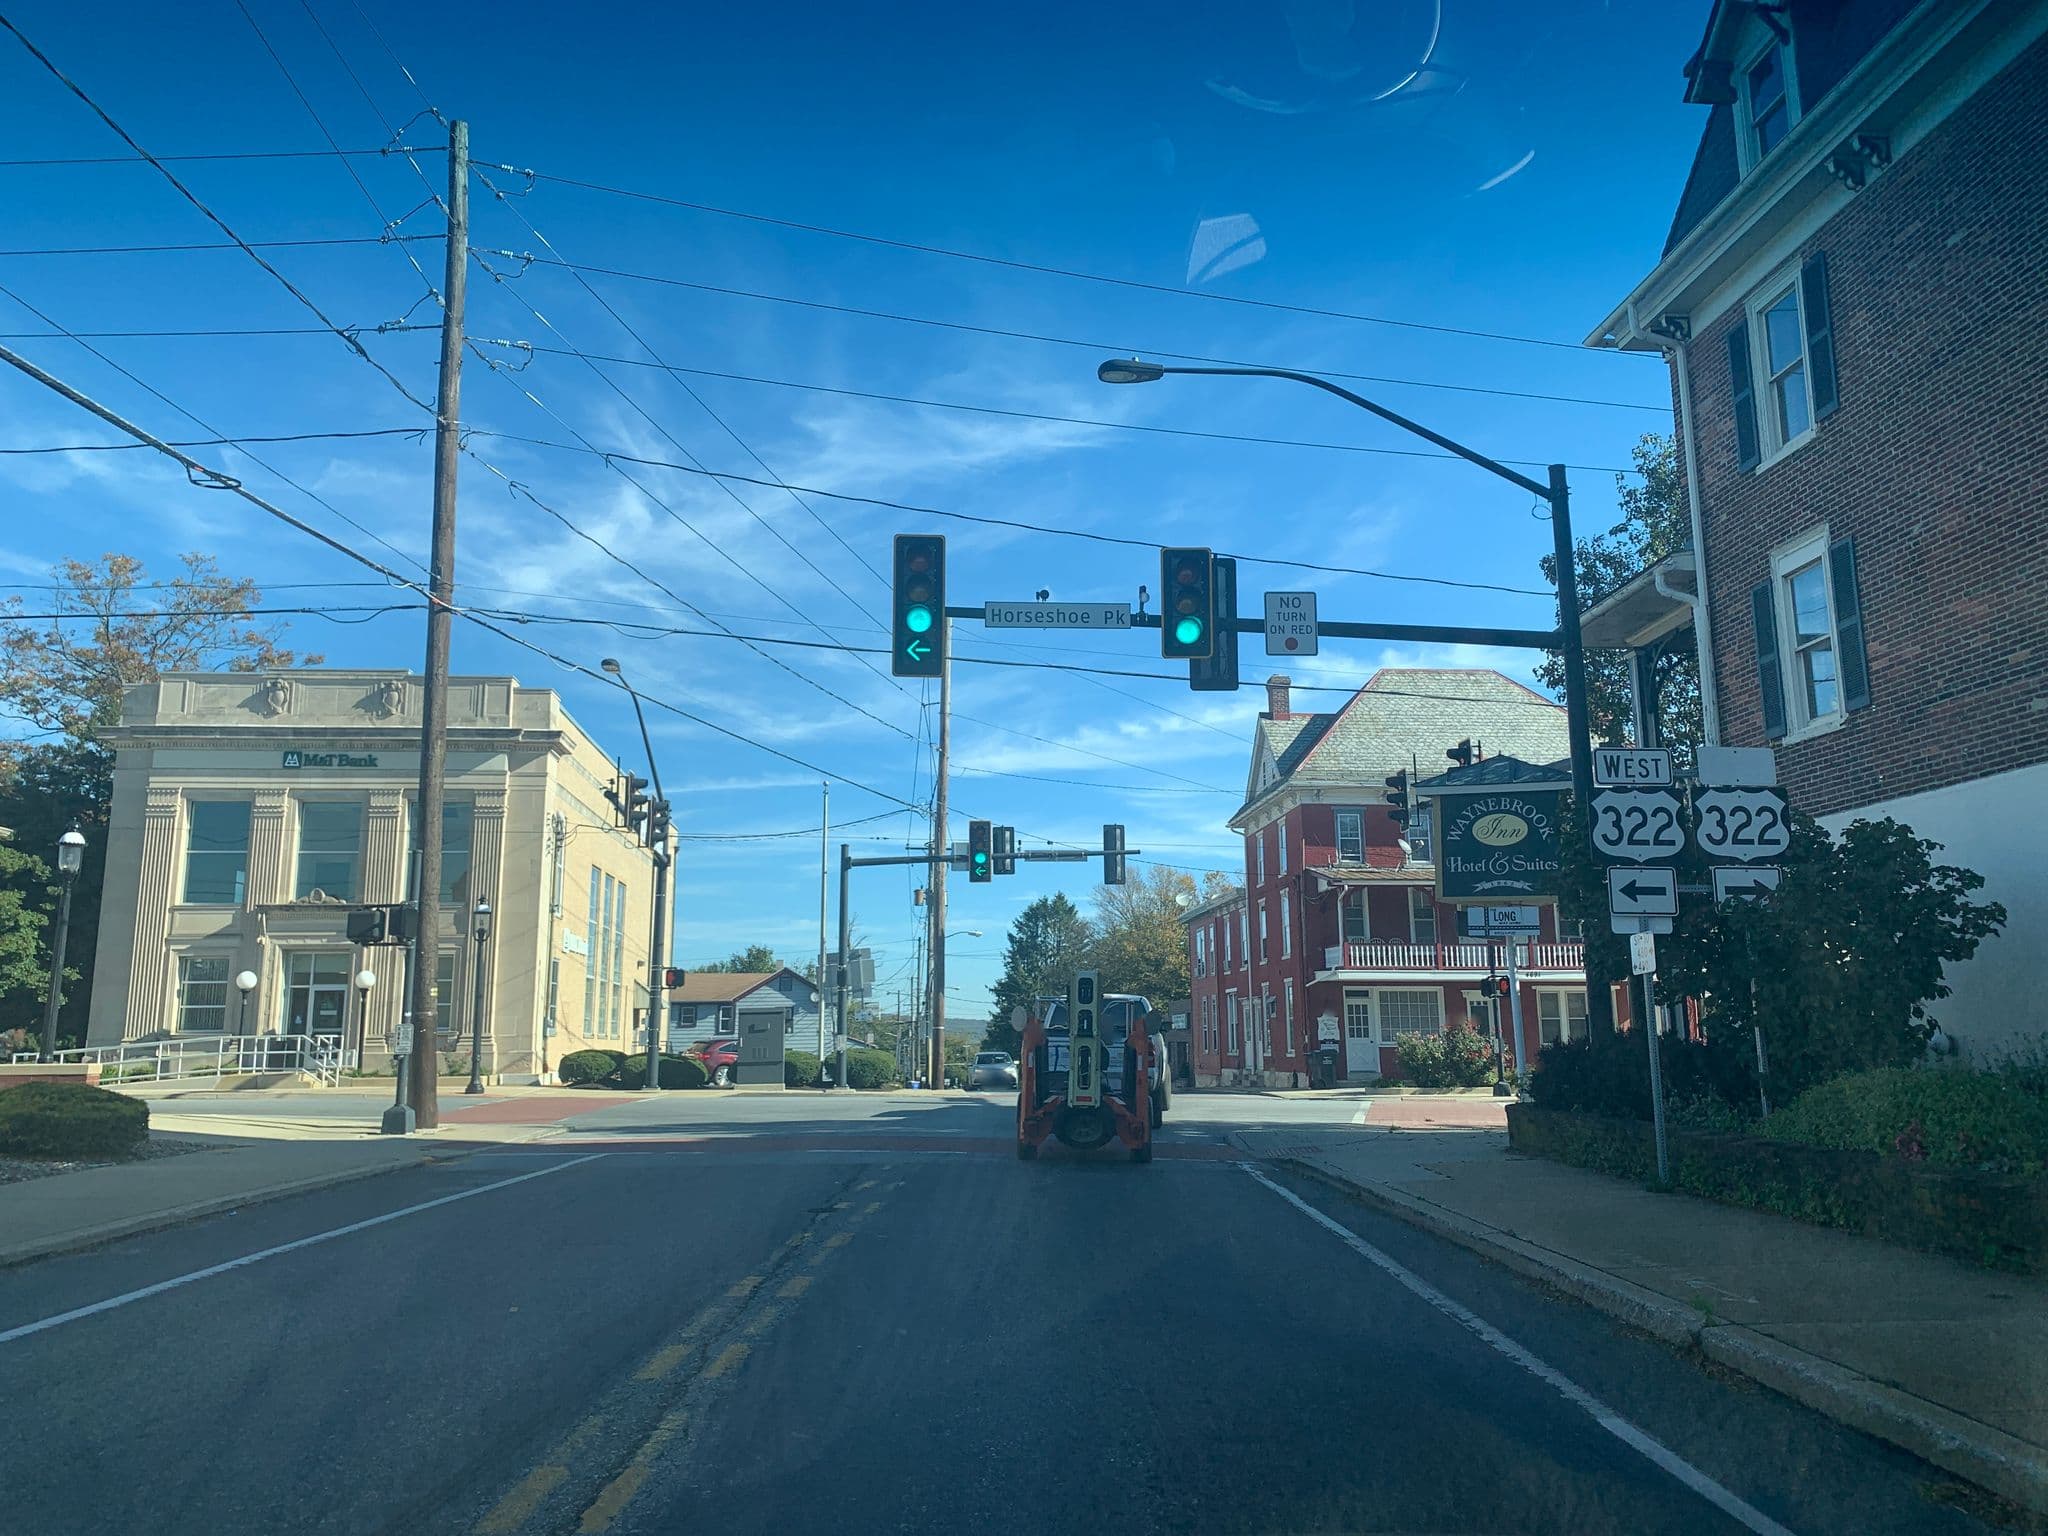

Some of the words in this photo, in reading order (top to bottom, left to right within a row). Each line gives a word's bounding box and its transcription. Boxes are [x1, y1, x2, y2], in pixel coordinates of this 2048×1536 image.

[1279, 596, 1302, 609] NO
[991, 608, 1091, 624] Horseshoe
[1104, 609, 1126, 625] Pk
[1276, 611, 1307, 622] TURN
[1270, 624, 1285, 635] ON
[1291, 624, 1313, 635] RED
[337, 753, 379, 768] Bank
[1603, 754, 1662, 779] WEST
[1447, 797, 1555, 841] WAYNEBROOK
[1477, 815, 1523, 840] Inn
[1601, 805, 1677, 847] 322
[1704, 805, 1782, 846] 322
[1446, 856, 1486, 873] Hotel
[1489, 851, 1510, 875] &
[1511, 854, 1559, 872] Suites
[1493, 910, 1517, 922] LONG
